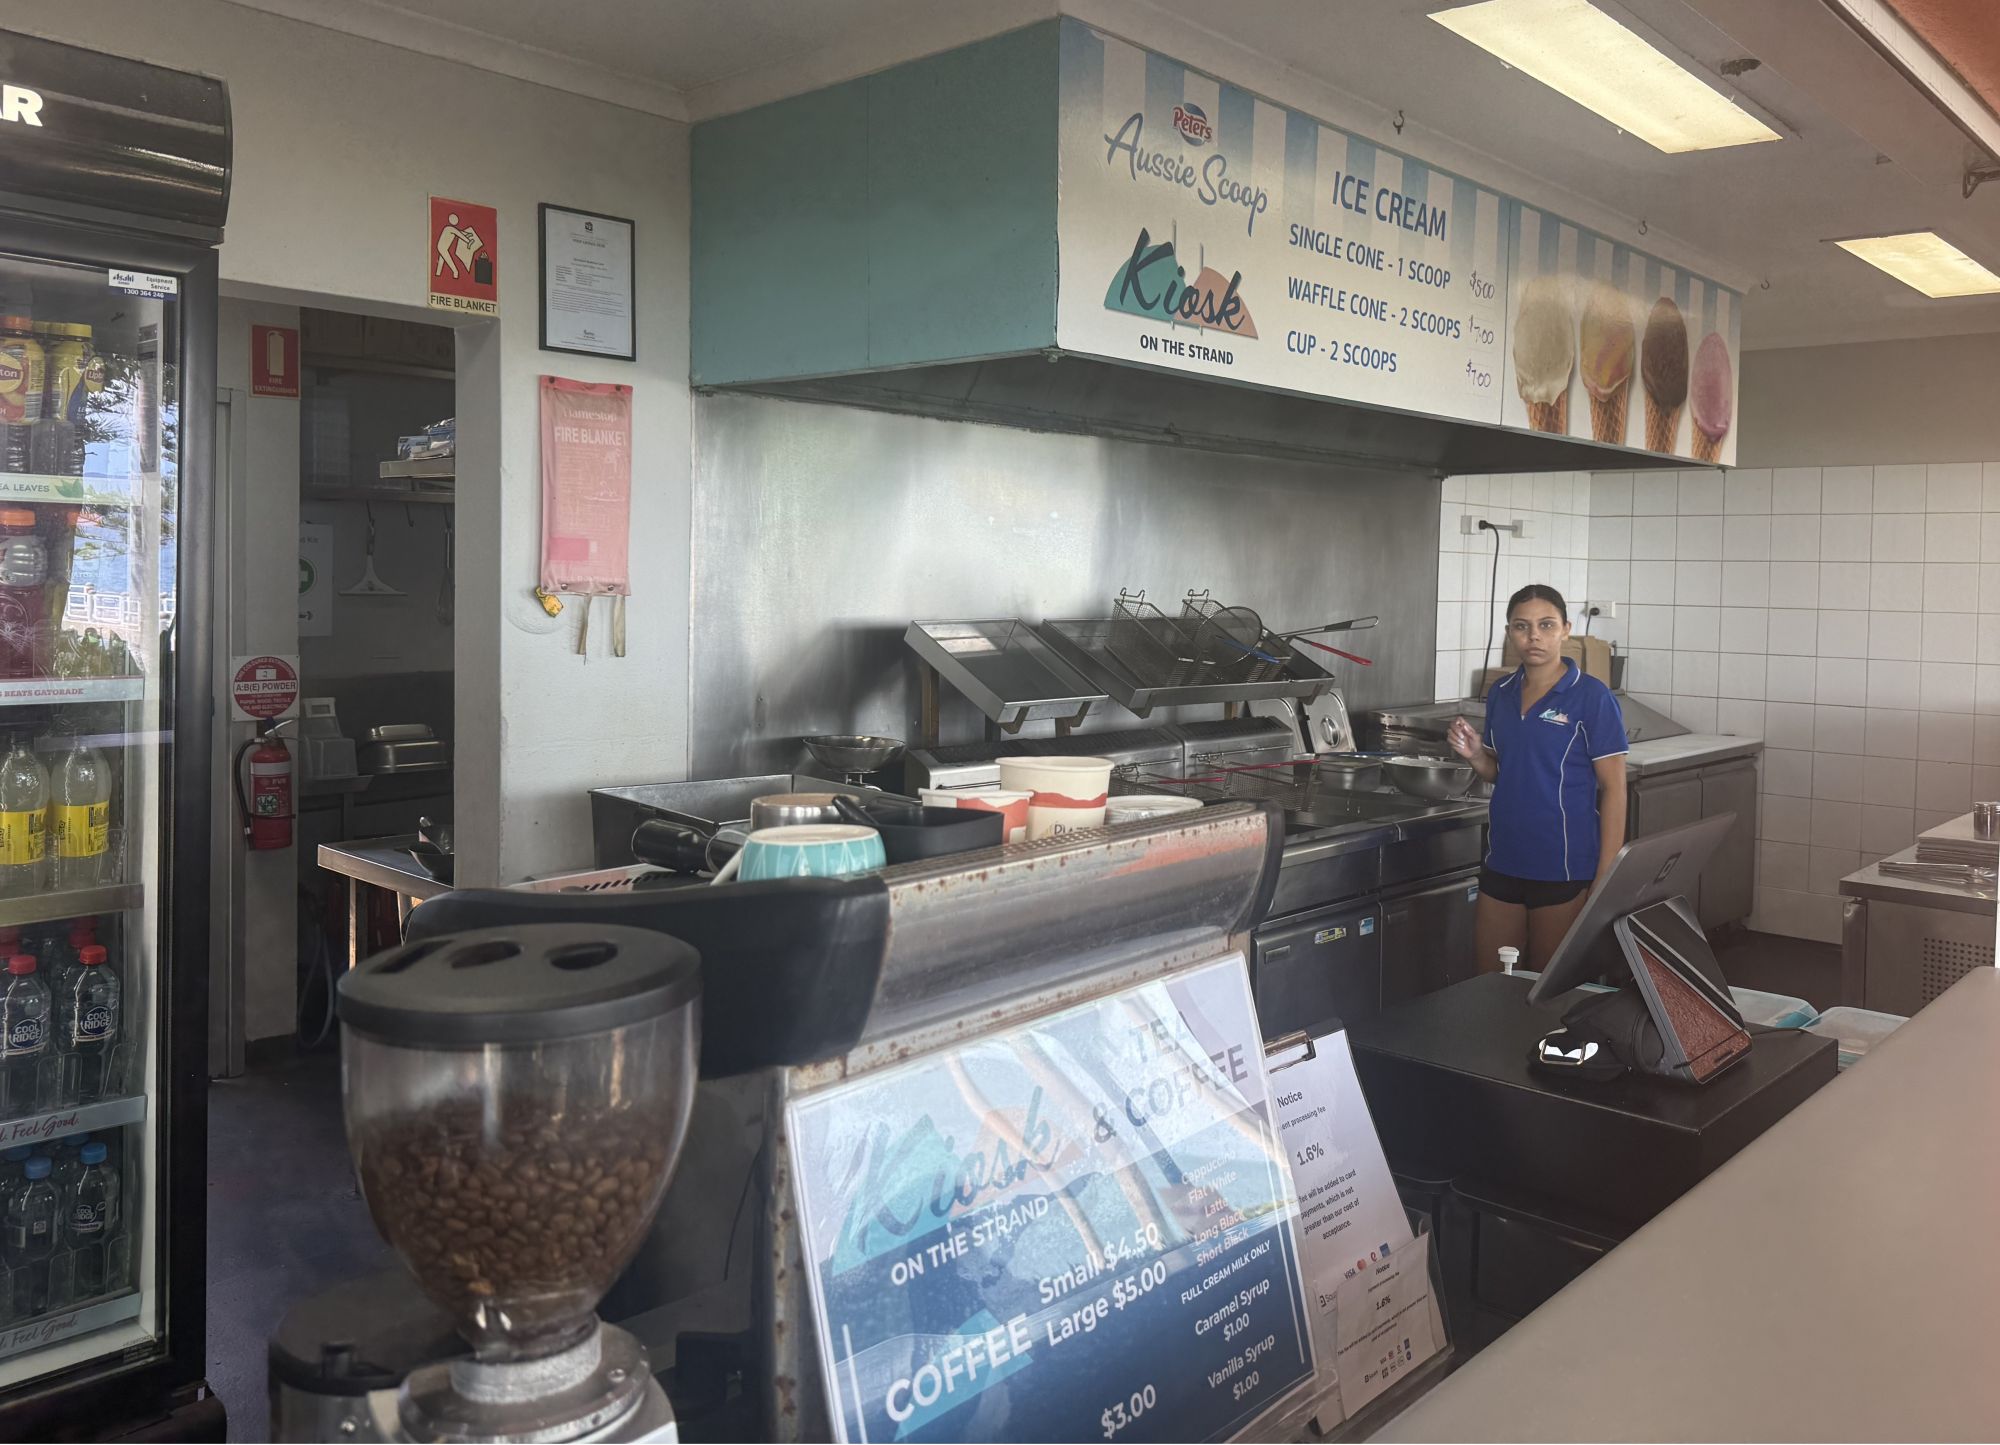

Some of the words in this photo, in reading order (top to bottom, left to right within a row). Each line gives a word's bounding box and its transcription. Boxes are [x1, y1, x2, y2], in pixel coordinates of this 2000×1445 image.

[1173, 106, 1212, 140] Peters
[1104, 112, 1197, 188] Aussie
[1198, 154, 1268, 238] Scoop
[1332, 171, 1370, 214] ICE
[1375, 188, 1446, 241] CREAM
[1289, 224, 1342, 258] SINGLE
[1346, 241, 1384, 270] CONE
[1398, 258, 1404, 276] 1
[1408, 260, 1451, 290] SCOOP
[113, 273, 134, 282] Asahi
[146, 276, 173, 284] Equipment
[1120, 227, 1245, 330] Kiosk
[430, 295, 452, 306] FIRE
[454, 298, 497, 313] BLANKET
[1288, 276, 1346, 312] WAFFLE
[1350, 294, 1388, 322] CONE
[1400, 308, 1408, 326] 2
[1412, 310, 1461, 339] SCOOPS
[1140, 334, 1158, 350] ON
[1162, 338, 1184, 356] THE
[1188, 344, 1234, 364] STRAND
[1287, 330, 1316, 355] CUP
[1330, 340, 1338, 360] 2
[1342, 342, 1397, 372] SCOOPS
[554, 426, 579, 443] FIRE
[14, 484, 50, 492] LEAVES
[34, 688, 84, 696] GATORADE
[262, 682, 296, 690] POWDER
[14, 1024, 38, 1034] COOL
[84, 1018, 110, 1030] RIDGE
[86, 1011, 110, 1021] COOL
[12, 1032, 40, 1042] RIDGE
[1092, 1102, 1116, 1143] &
[1125, 1044, 1248, 1127] COFFEE
[1276, 1090, 1303, 1108] Notice
[12, 1120, 40, 1140] Feel
[1291, 1108, 1318, 1128] processing
[1317, 1105, 1326, 1116] fee
[857, 1085, 1061, 1255] Kiosk
[1180, 1150, 1236, 1185] Cappuccino
[1296, 1142, 1324, 1166] 1.6%
[1188, 1186, 1208, 1204] Flat
[1209, 1170, 1238, 1190] White
[1308, 1188, 1318, 1200] will
[1316, 1185, 1324, 1194] be
[1324, 1176, 1340, 1192] added
[1338, 1175, 1346, 1184] to
[1344, 1168, 1356, 1180] card
[1204, 1198, 1229, 1218] Latte
[1301, 1201, 1326, 1220] payments,
[1326, 1192, 1341, 1206] which
[1340, 1190, 1346, 1198] is
[1345, 1186, 1354, 1196] not
[1304, 1220, 1322, 1235] greater
[1322, 1212, 1336, 1226] than
[1335, 1208, 1344, 1216] our
[1343, 1202, 1354, 1212] cost
[1354, 1198, 1360, 1208] of
[890, 1253, 924, 1286] ON
[926, 1232, 968, 1269] THE
[972, 1196, 1048, 1248] STRAND
[1194, 1223, 1219, 1246] Long
[1219, 1208, 1246, 1230] Black
[1322, 1220, 1352, 1240] acceptance.
[1038, 1252, 1100, 1304] Small
[1103, 1222, 1160, 1271] $4.50
[1196, 1243, 1224, 1267] Short
[1224, 1227, 1250, 1249] Black
[1180, 1284, 1203, 1304] FULL
[1202, 1266, 1230, 1290] CREAM
[1231, 1252, 1250, 1272] MILK
[1250, 1240, 1270, 1260] ONLY
[1376, 1263, 1390, 1276] Notice
[1046, 1297, 1109, 1347] Large
[1112, 1260, 1166, 1310] $5.00
[1194, 1295, 1239, 1336] Caramel
[1239, 1278, 1270, 1309] Syrup
[11, 1326, 39, 1348] Feel
[1223, 1312, 1250, 1342] $1.00
[886, 1312, 1033, 1422] COFFEE
[1208, 1355, 1244, 1389] Vanilla
[1244, 1334, 1275, 1366] Syrup
[1232, 1371, 1260, 1401] $1.00
[1101, 1384, 1156, 1440] $3.00
